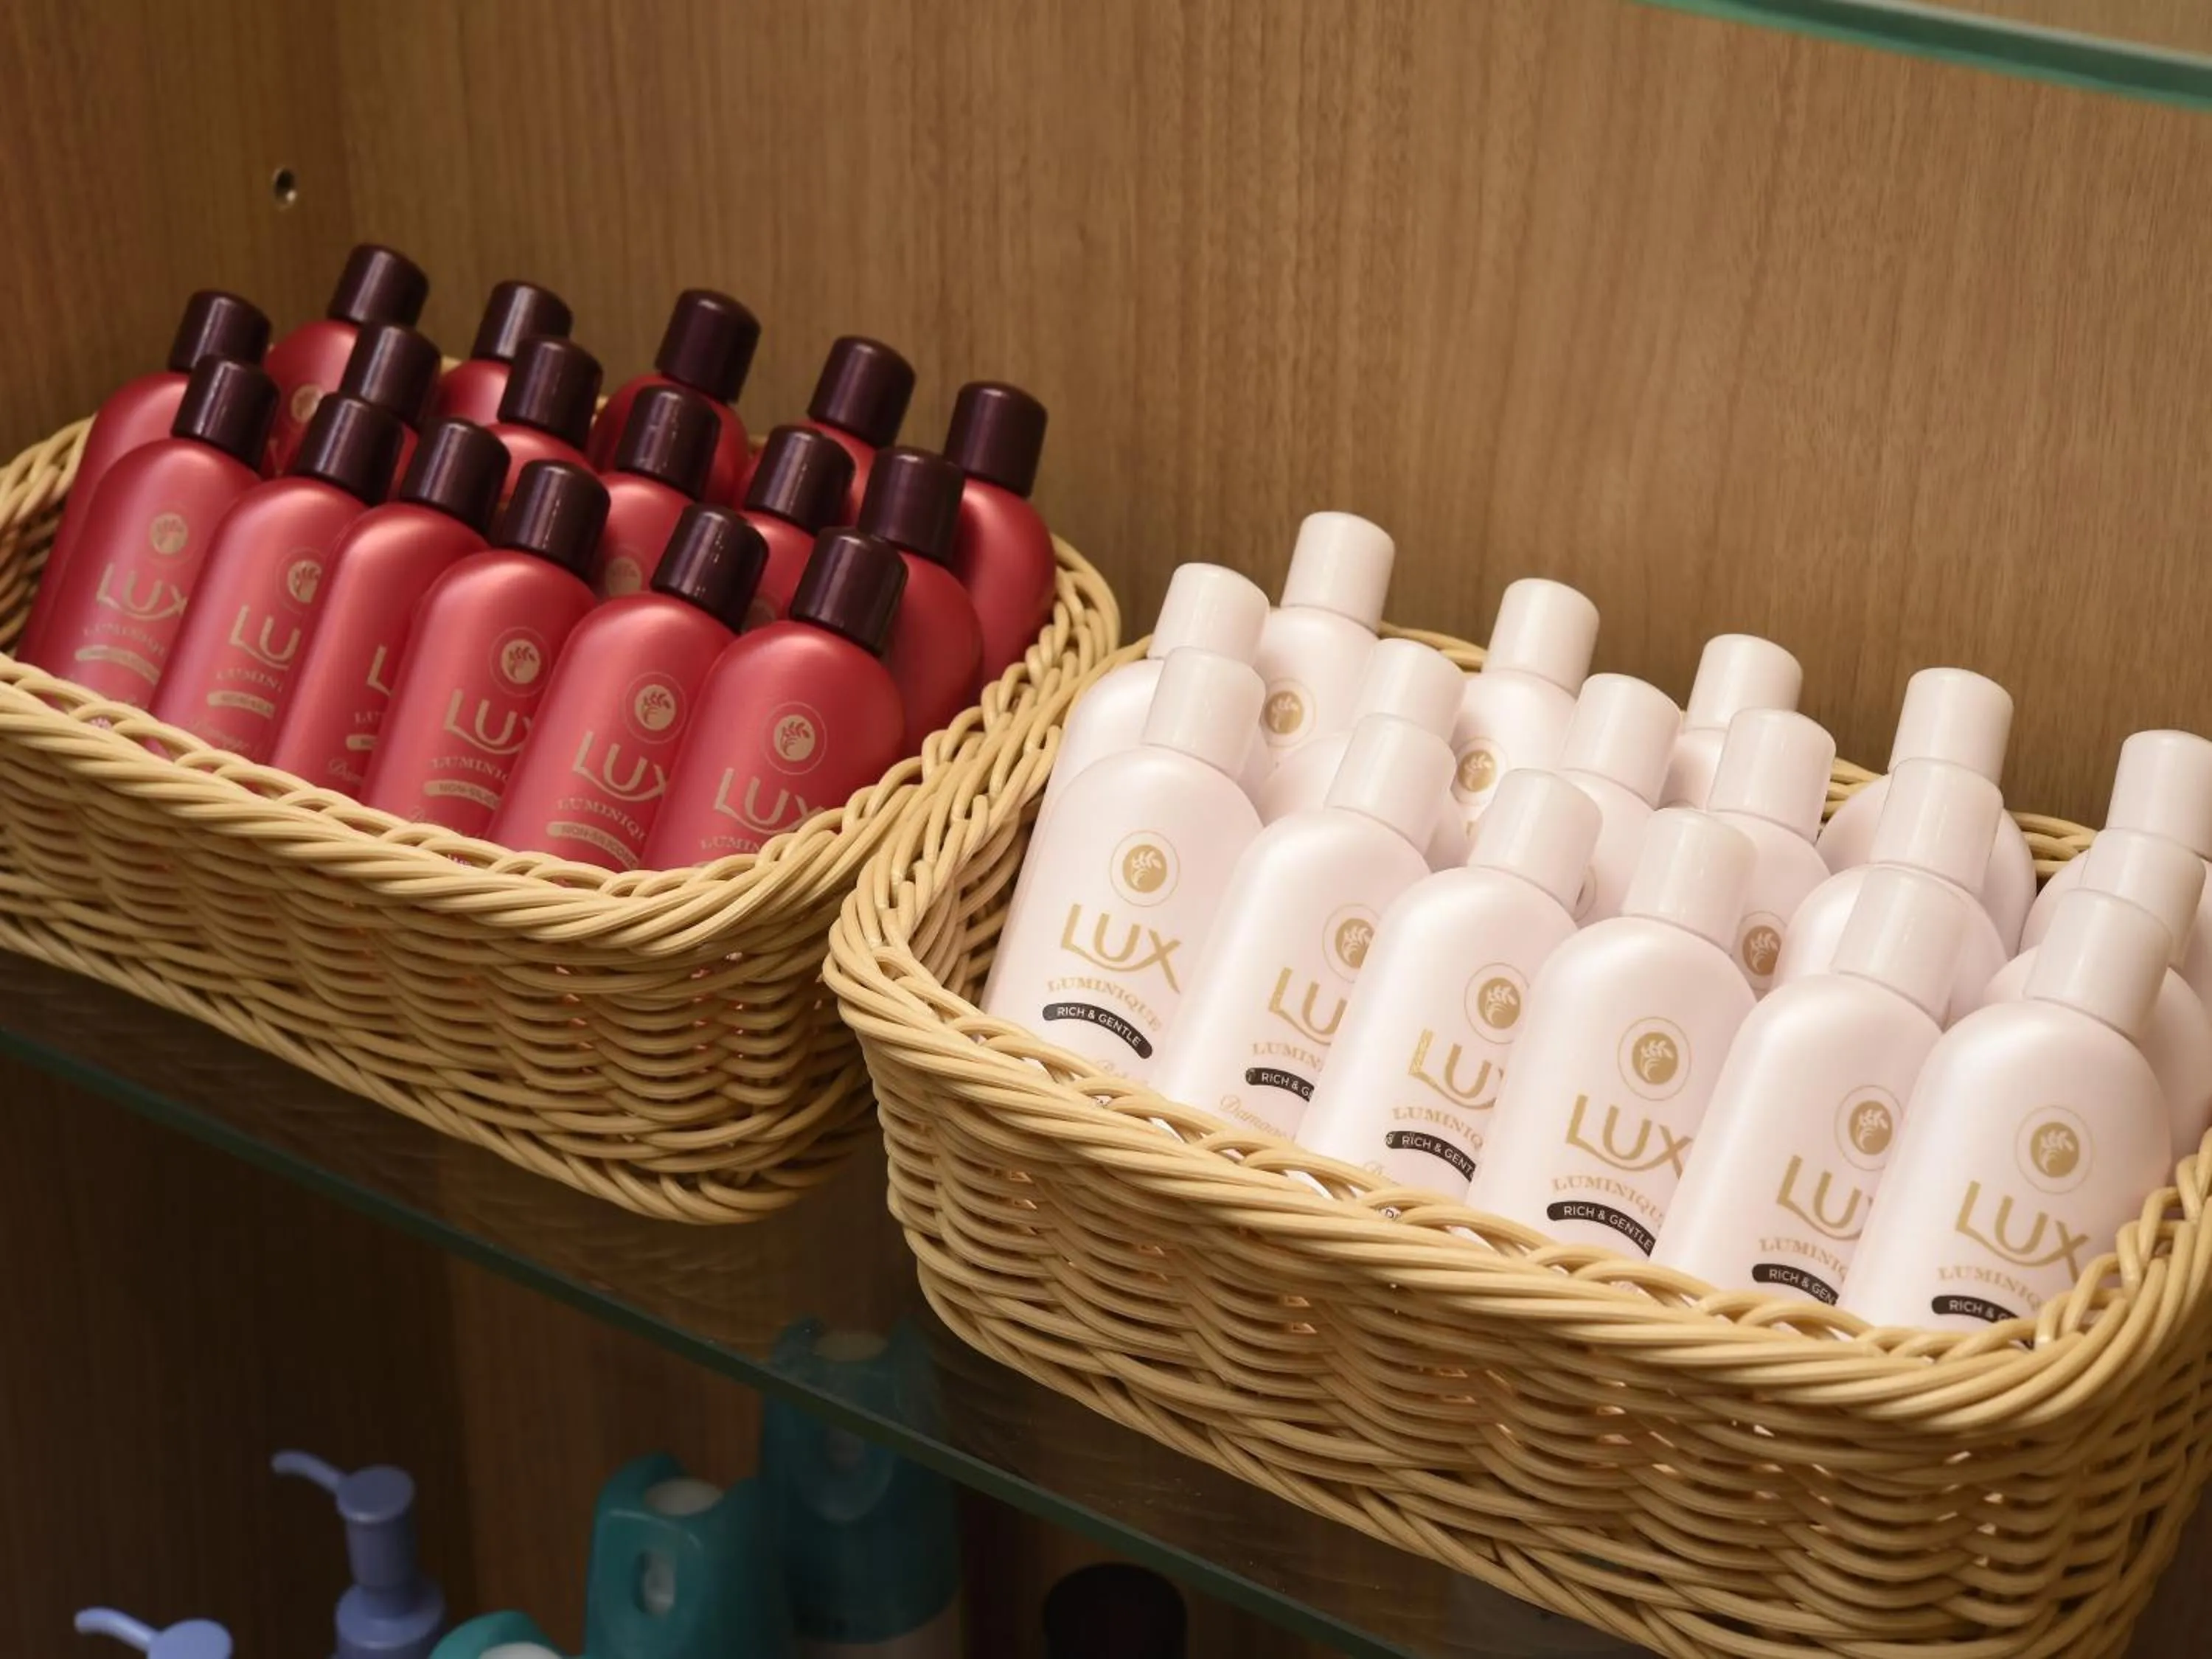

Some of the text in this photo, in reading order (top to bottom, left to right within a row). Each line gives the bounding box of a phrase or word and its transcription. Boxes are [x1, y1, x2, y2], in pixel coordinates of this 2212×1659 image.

[229, 605, 301, 670] LU
[429, 756, 509, 784] LUMINI
[700, 835, 760, 852] LUMIN
[1060, 904, 1181, 993] LUX
[1047, 977, 1163, 1032] LUMINIQUE
[1057, 1006, 1143, 1046] RICH & GENTLE
[1268, 967, 1347, 1046] LU
[1253, 1041, 1323, 1072] LUMIN
[1408, 1029, 1504, 1110] LU
[1262, 1072, 1299, 1091] RICH &
[1392, 1106, 1484, 1152] LUMINIQ
[1565, 1094, 1694, 1180] LUX
[1402, 1135, 1475, 1178] RICH & GENT
[1776, 1155, 1874, 1240] LU
[1564, 1206, 1656, 1250] RICH & GENTLE
[1955, 1180, 2089, 1284] LUX
[1769, 1269, 1836, 1305] RICH & GEN
[1938, 1265, 2045, 1312] LUMINIQ
[1950, 1300, 1983, 1314] RICH
